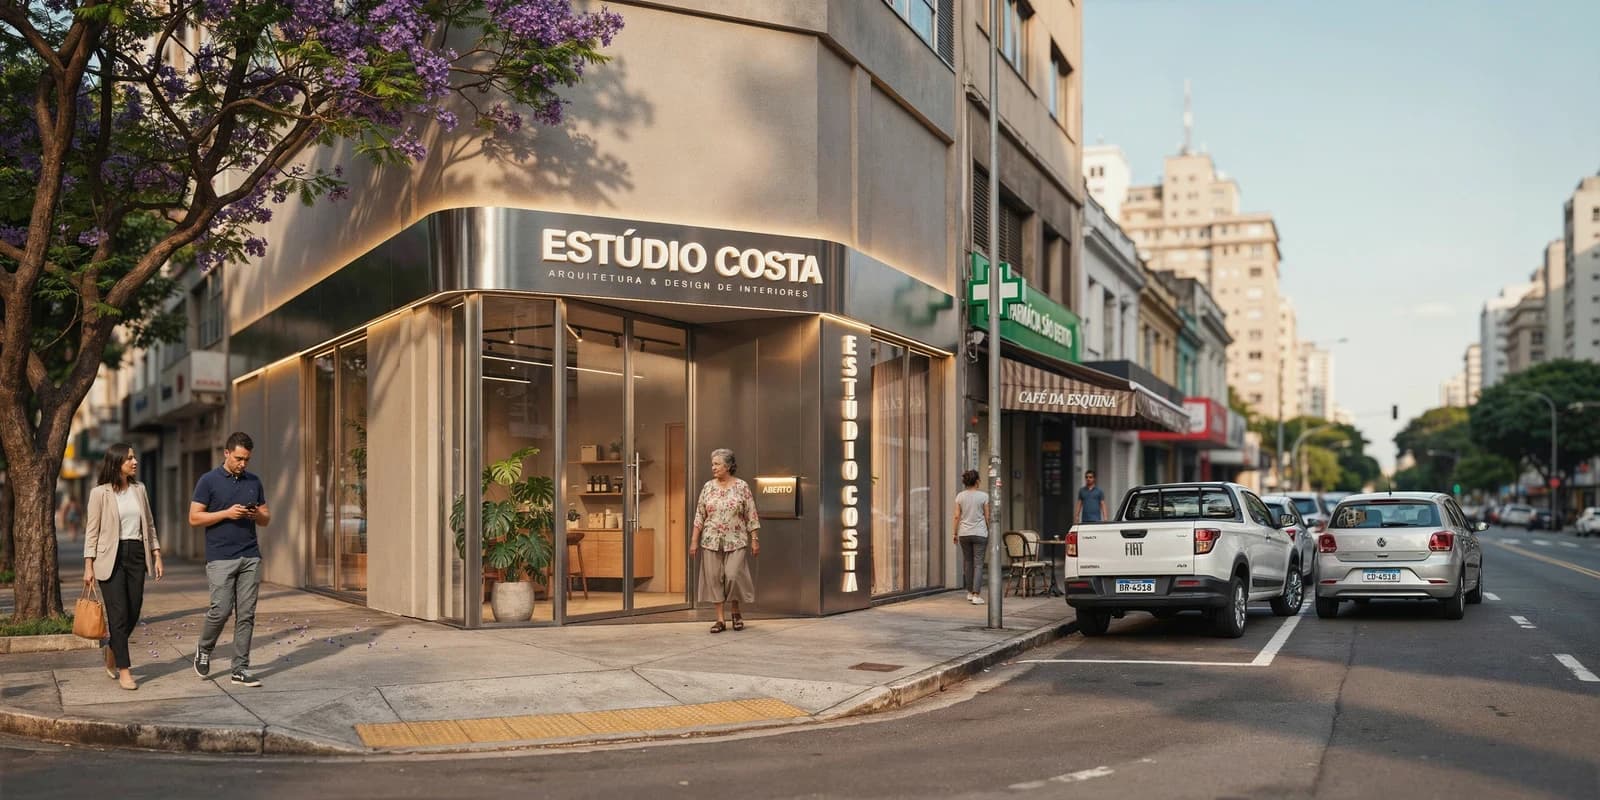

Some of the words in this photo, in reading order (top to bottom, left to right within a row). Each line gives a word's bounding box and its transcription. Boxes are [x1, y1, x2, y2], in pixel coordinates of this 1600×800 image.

[542, 228, 707, 274] ESTÚDIO
[714, 246, 824, 285] COSTA
[548, 269, 642, 285] ARQUITETURA
[650, 277, 657, 286] &
[664, 279, 711, 290] DESIGN
[717, 283, 733, 292] DE
[739, 285, 809, 298] INTERIORES
[1018, 389, 1047, 405] CAFÉ
[1048, 392, 1065, 406] DA
[1067, 393, 1117, 409] ESQUINA
[762, 485, 793, 494] ABERTO
[841, 485, 859, 593] COSTA
[1125, 541, 1144, 556] FIAT
[1119, 583, 1152, 592] BR-4518
